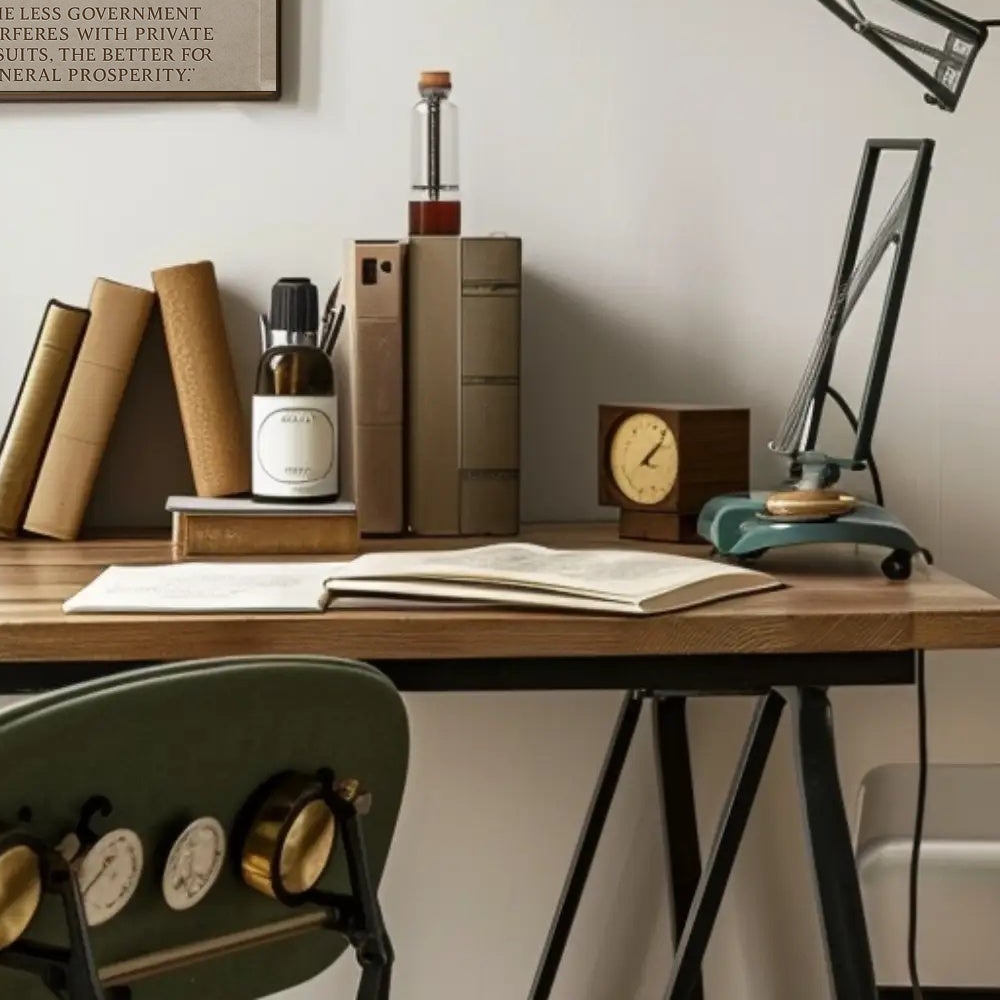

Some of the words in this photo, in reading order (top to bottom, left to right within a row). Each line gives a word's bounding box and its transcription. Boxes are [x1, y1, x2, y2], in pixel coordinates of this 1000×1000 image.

[19, 6, 62, 21] LESS
[67, 6, 202, 21] GOVERNMENT
[75, 27, 128, 41] WITH
[135, 26, 214, 41] PRIVATE
[58, 47, 96, 62] THE
[102, 47, 176, 62] BETTER
[181, 47, 214, 62] FOR
